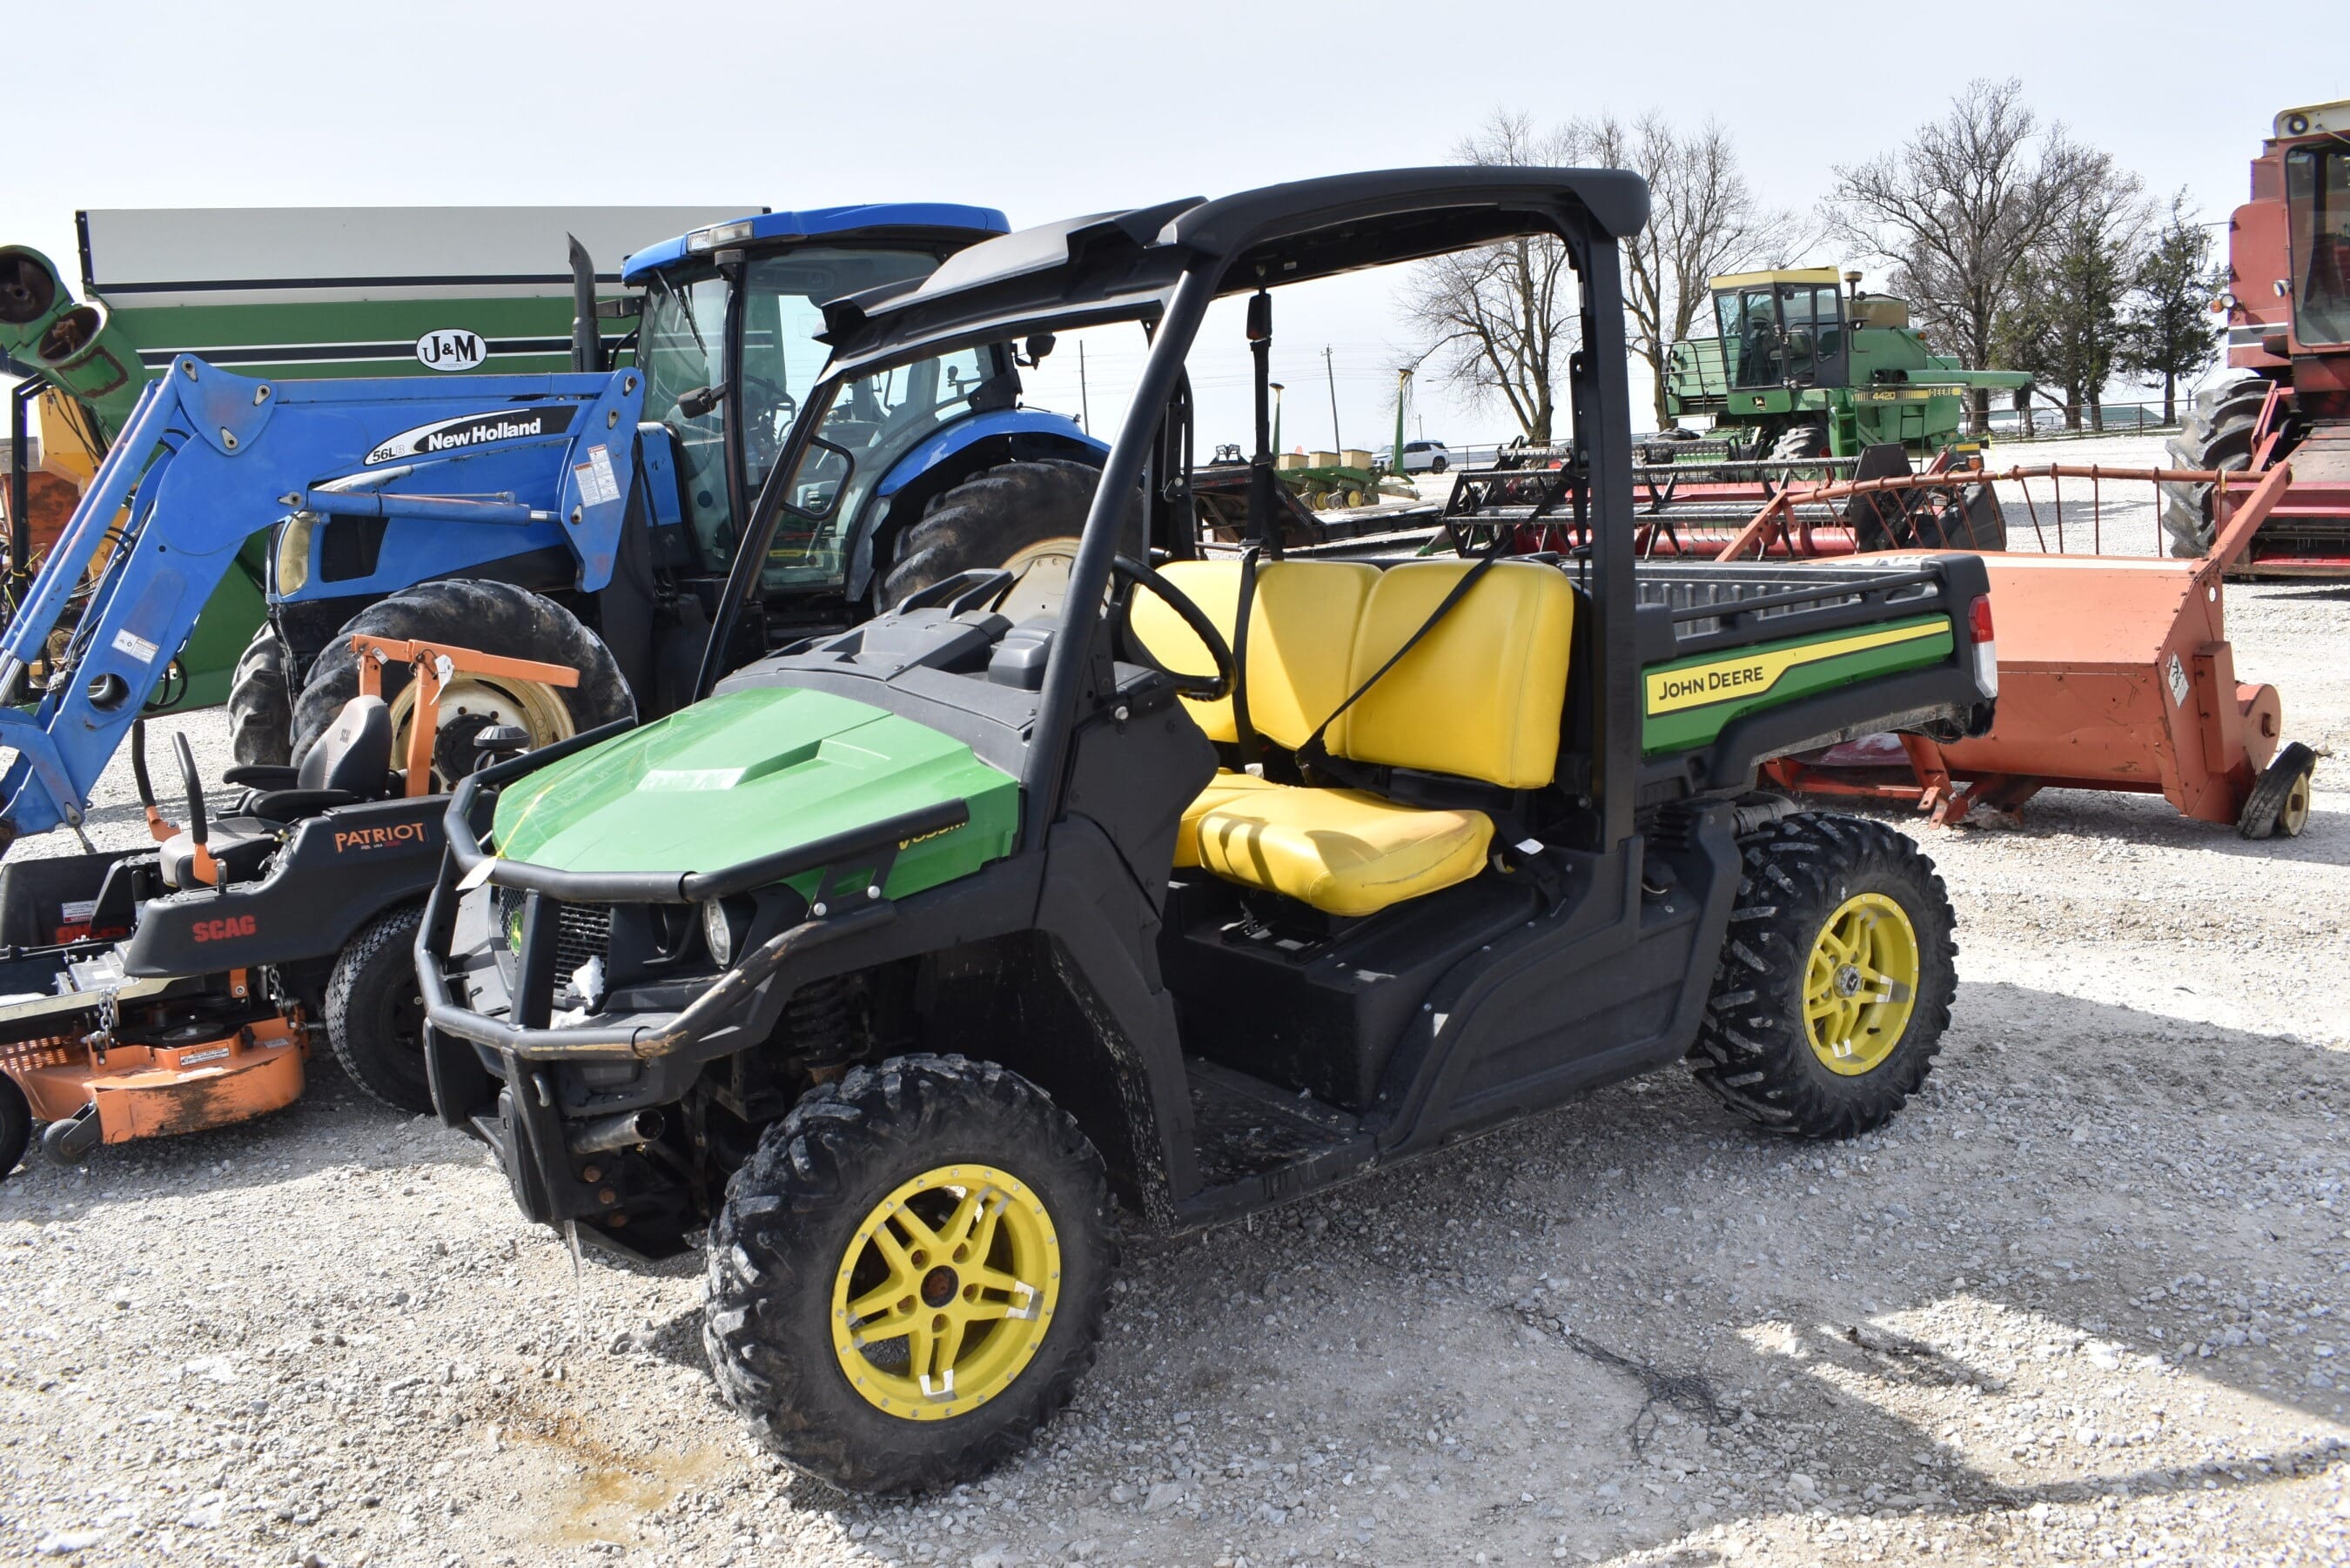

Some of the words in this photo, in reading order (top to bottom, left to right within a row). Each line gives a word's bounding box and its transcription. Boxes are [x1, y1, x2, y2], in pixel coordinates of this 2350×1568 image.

[422, 335, 479, 363] J&M
[1872, 391, 1896, 400] 4420
[428, 431, 471, 452] New
[472, 418, 541, 443] Holland
[1659, 677, 1704, 700] JOHN
[1709, 666, 1764, 691] DEERE
[334, 822, 424, 853] PATRIOT
[192, 915, 257, 942] SCAG
